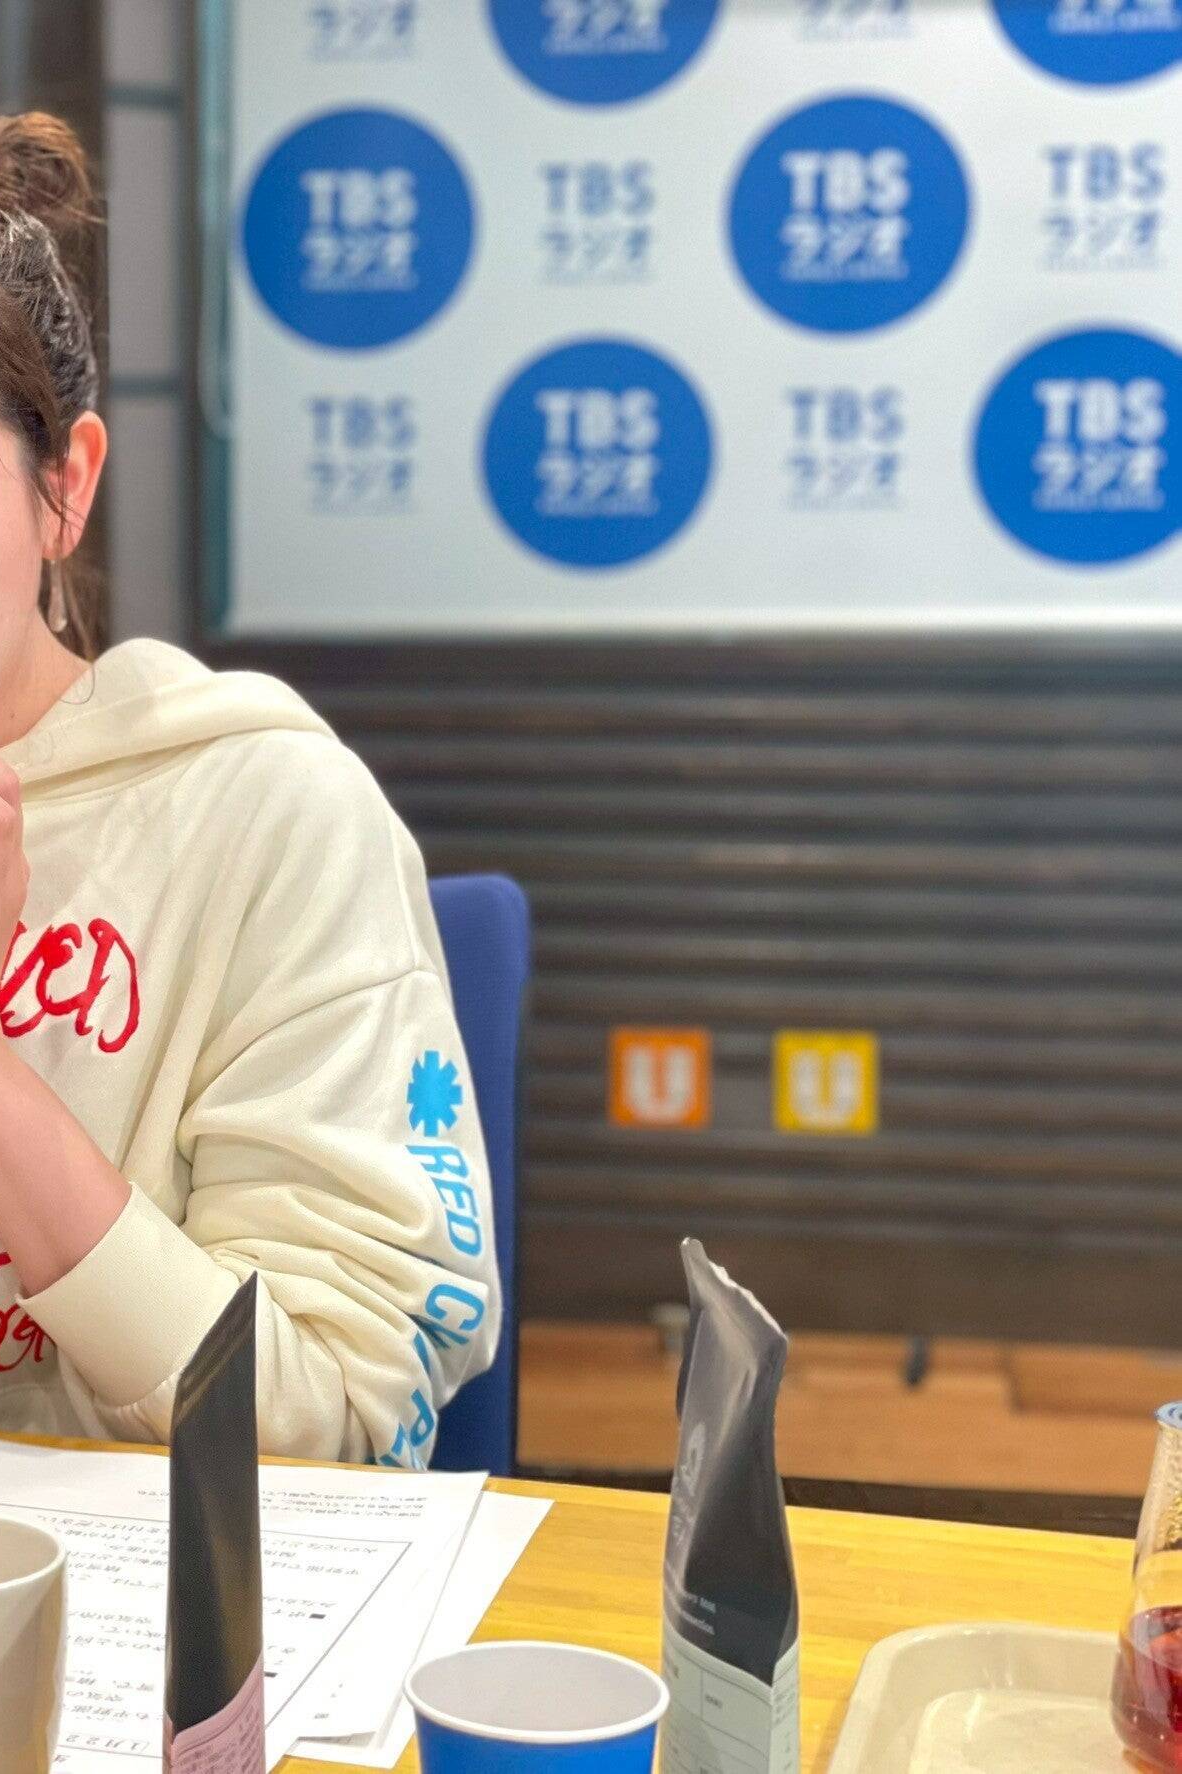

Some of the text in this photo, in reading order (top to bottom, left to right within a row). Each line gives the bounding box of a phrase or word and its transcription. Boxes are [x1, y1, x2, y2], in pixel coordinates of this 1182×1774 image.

[302, 168, 417, 228] TBS
[540, 160, 654, 216] TBS
[779, 147, 912, 213] TBS
[1040, 144, 1165, 201] TBS
[305, 396, 418, 451] TBS
[535, 390, 661, 452] TBS
[784, 387, 905, 445] TBS
[1033, 379, 1166, 444] TBS
[623, 1045, 696, 1124] U
[789, 1049, 863, 1127] U
[405, 1143, 483, 1259] RED
